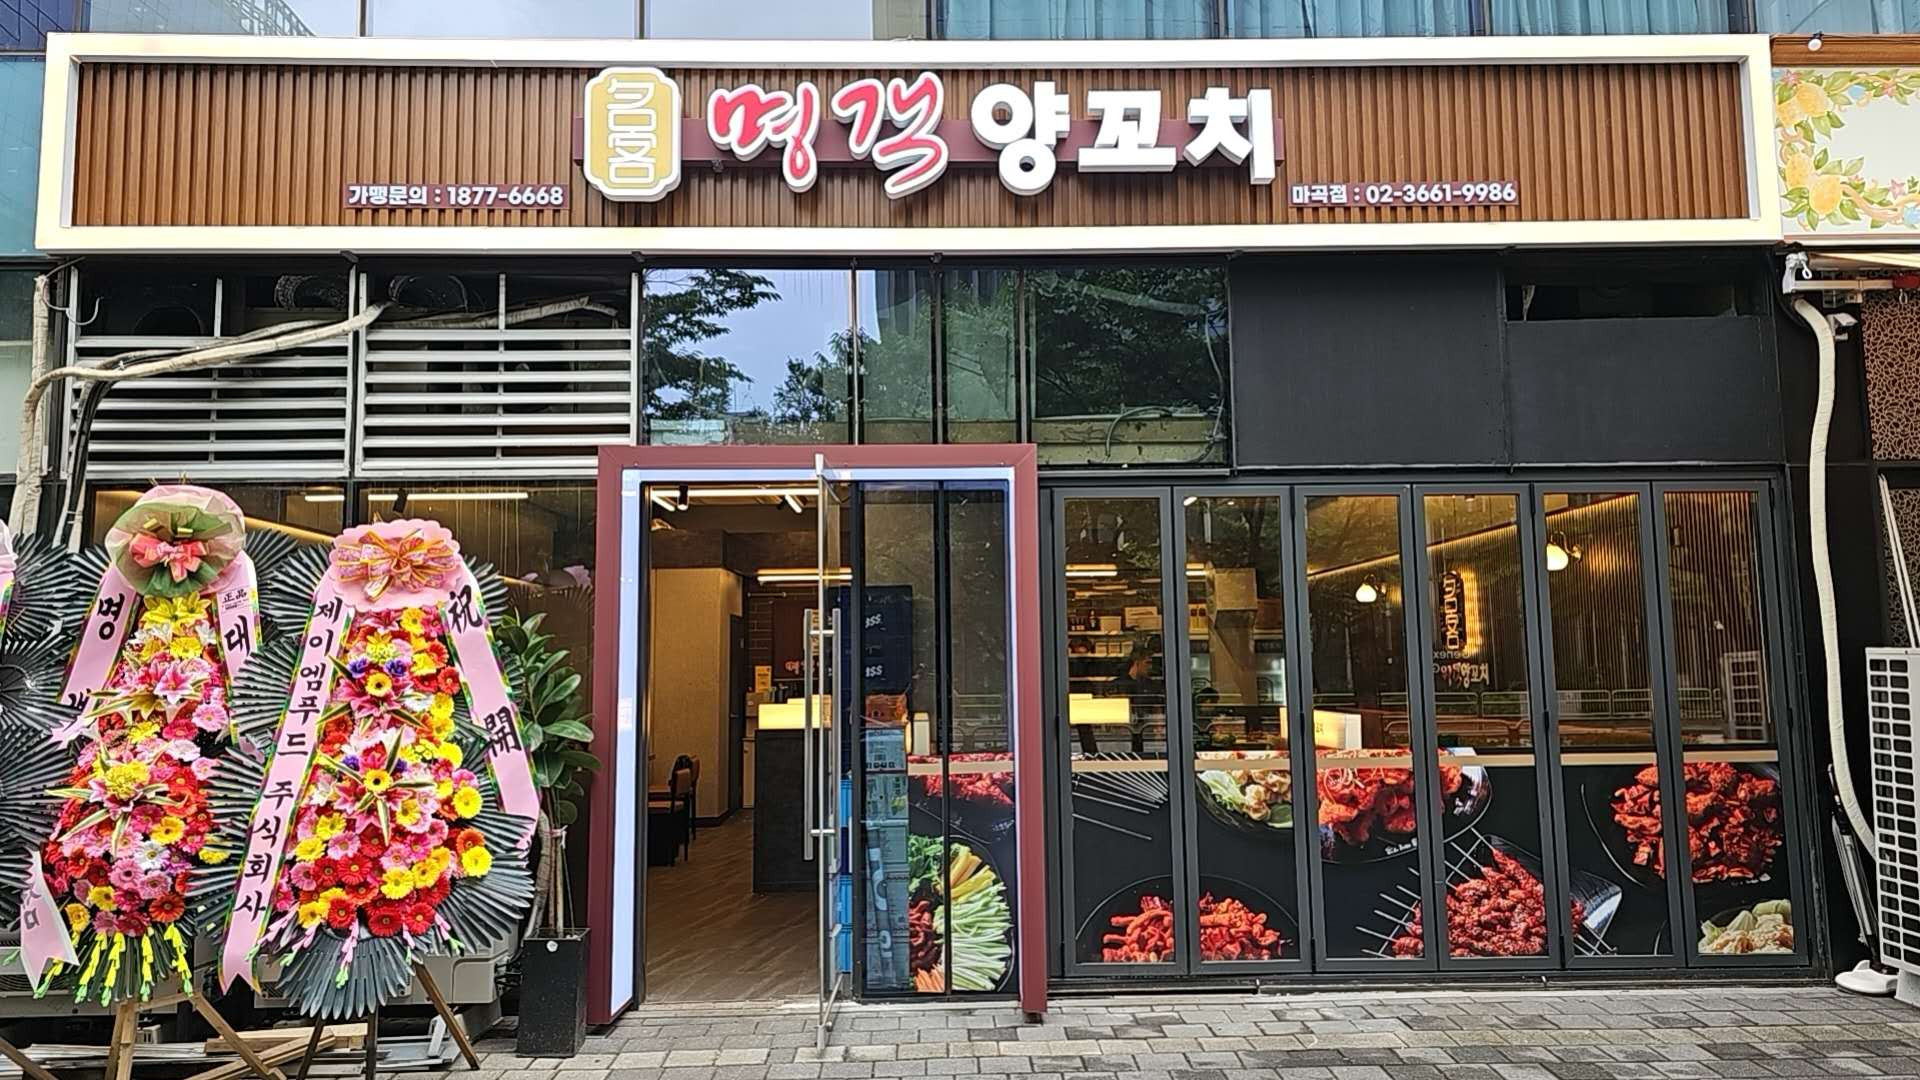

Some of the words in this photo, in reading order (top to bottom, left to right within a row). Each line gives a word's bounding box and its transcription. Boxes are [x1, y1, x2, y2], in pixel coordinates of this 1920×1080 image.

[970, 81, 1276, 196] 양꼬치
[349, 186, 427, 205] 가맹문의
[447, 186, 563, 205] 1877-6668
[1292, 184, 1348, 203] 마곡점
[1366, 183, 1517, 203] 02-3661-9986
[97, 593, 125, 640] 명
[224, 615, 250, 657] 대
[277, 596, 342, 755] 제이엠푸드
[233, 780, 294, 922] 주식회사
